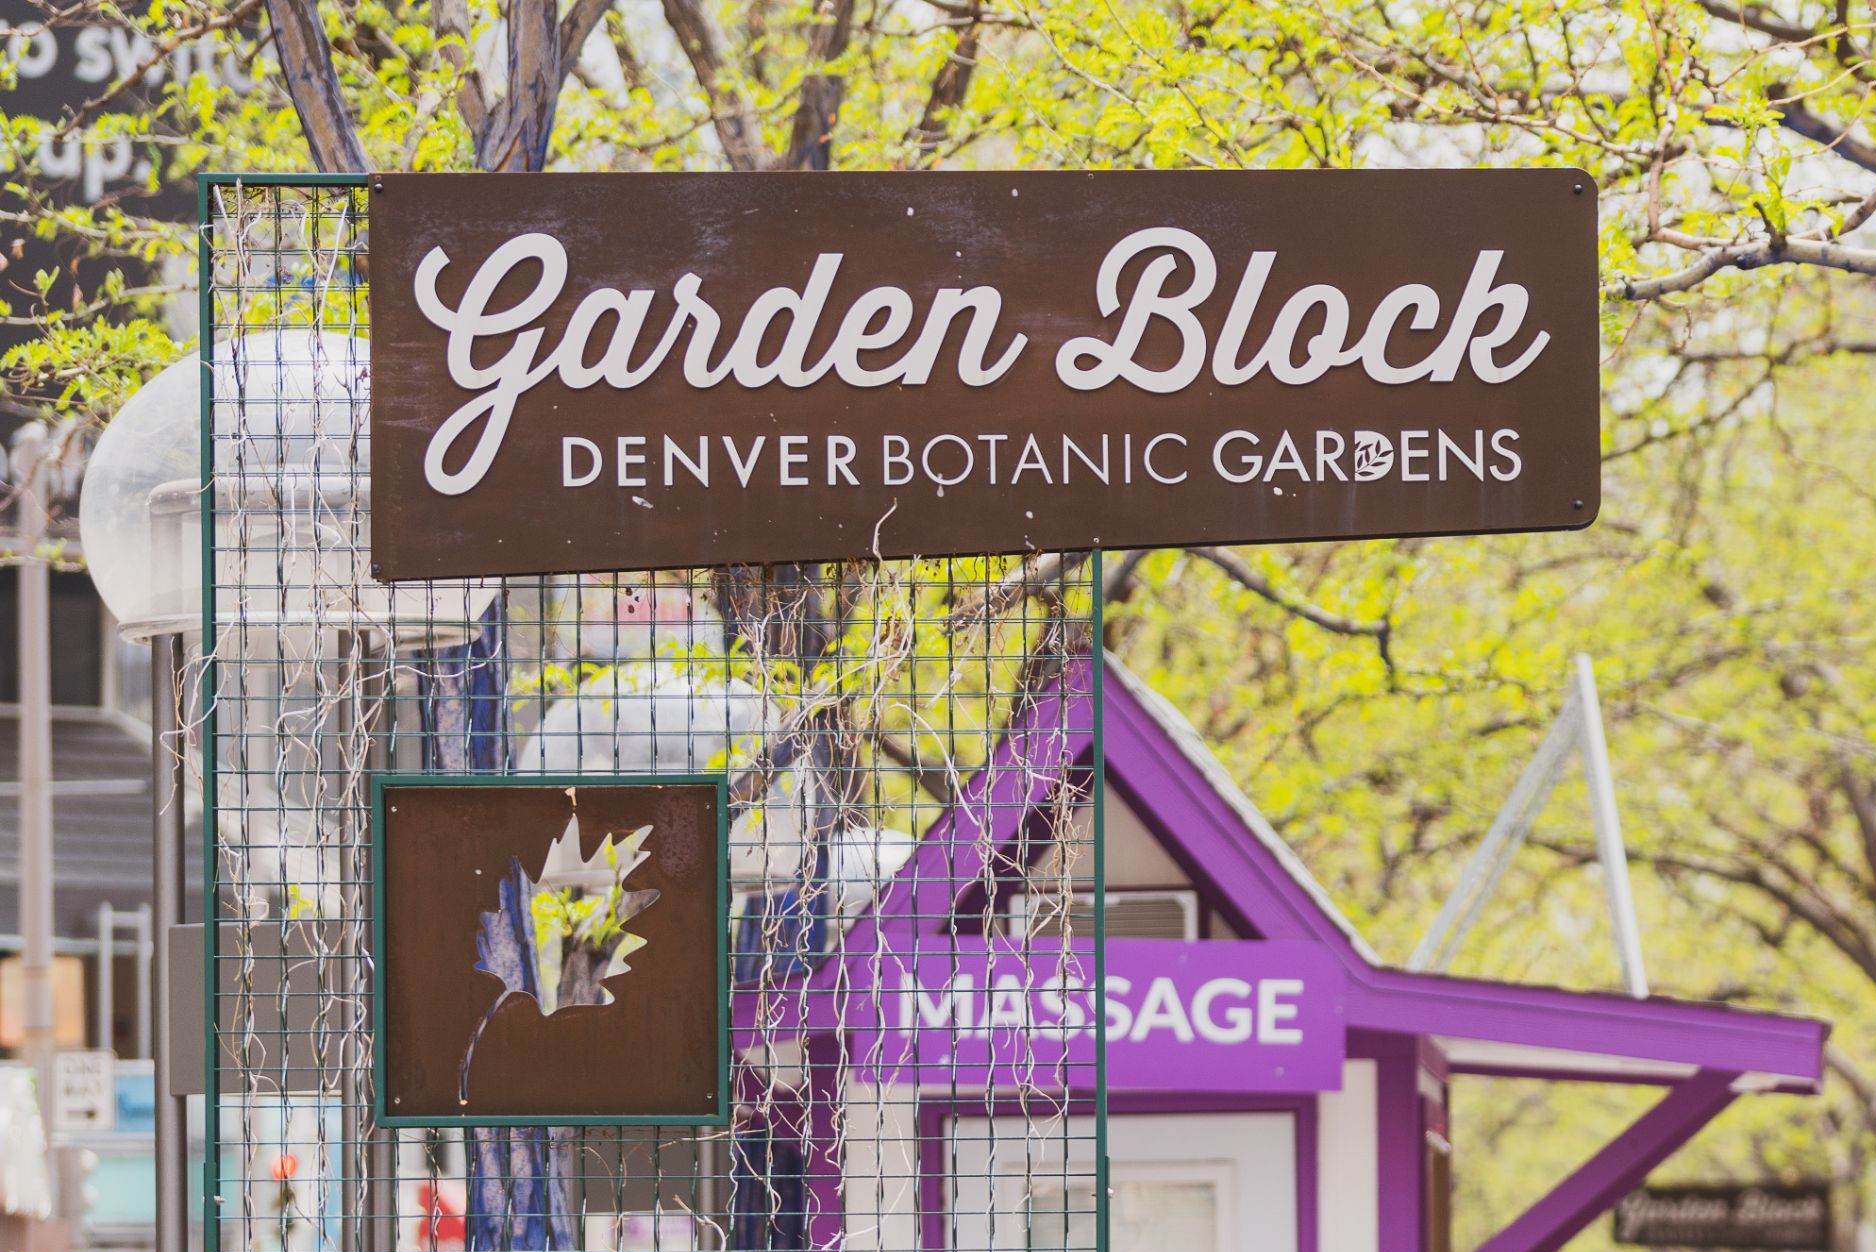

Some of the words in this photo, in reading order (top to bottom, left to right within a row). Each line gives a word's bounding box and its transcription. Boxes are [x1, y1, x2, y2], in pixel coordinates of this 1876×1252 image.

[413, 231, 1028, 496] Garden
[1055, 227, 1551, 394] Block
[562, 434, 860, 488] DENVER
[883, 433, 1188, 486] BOTANIC
[1213, 428, 1522, 483] GARDENS
[899, 973, 1304, 1044] MASSAGE
